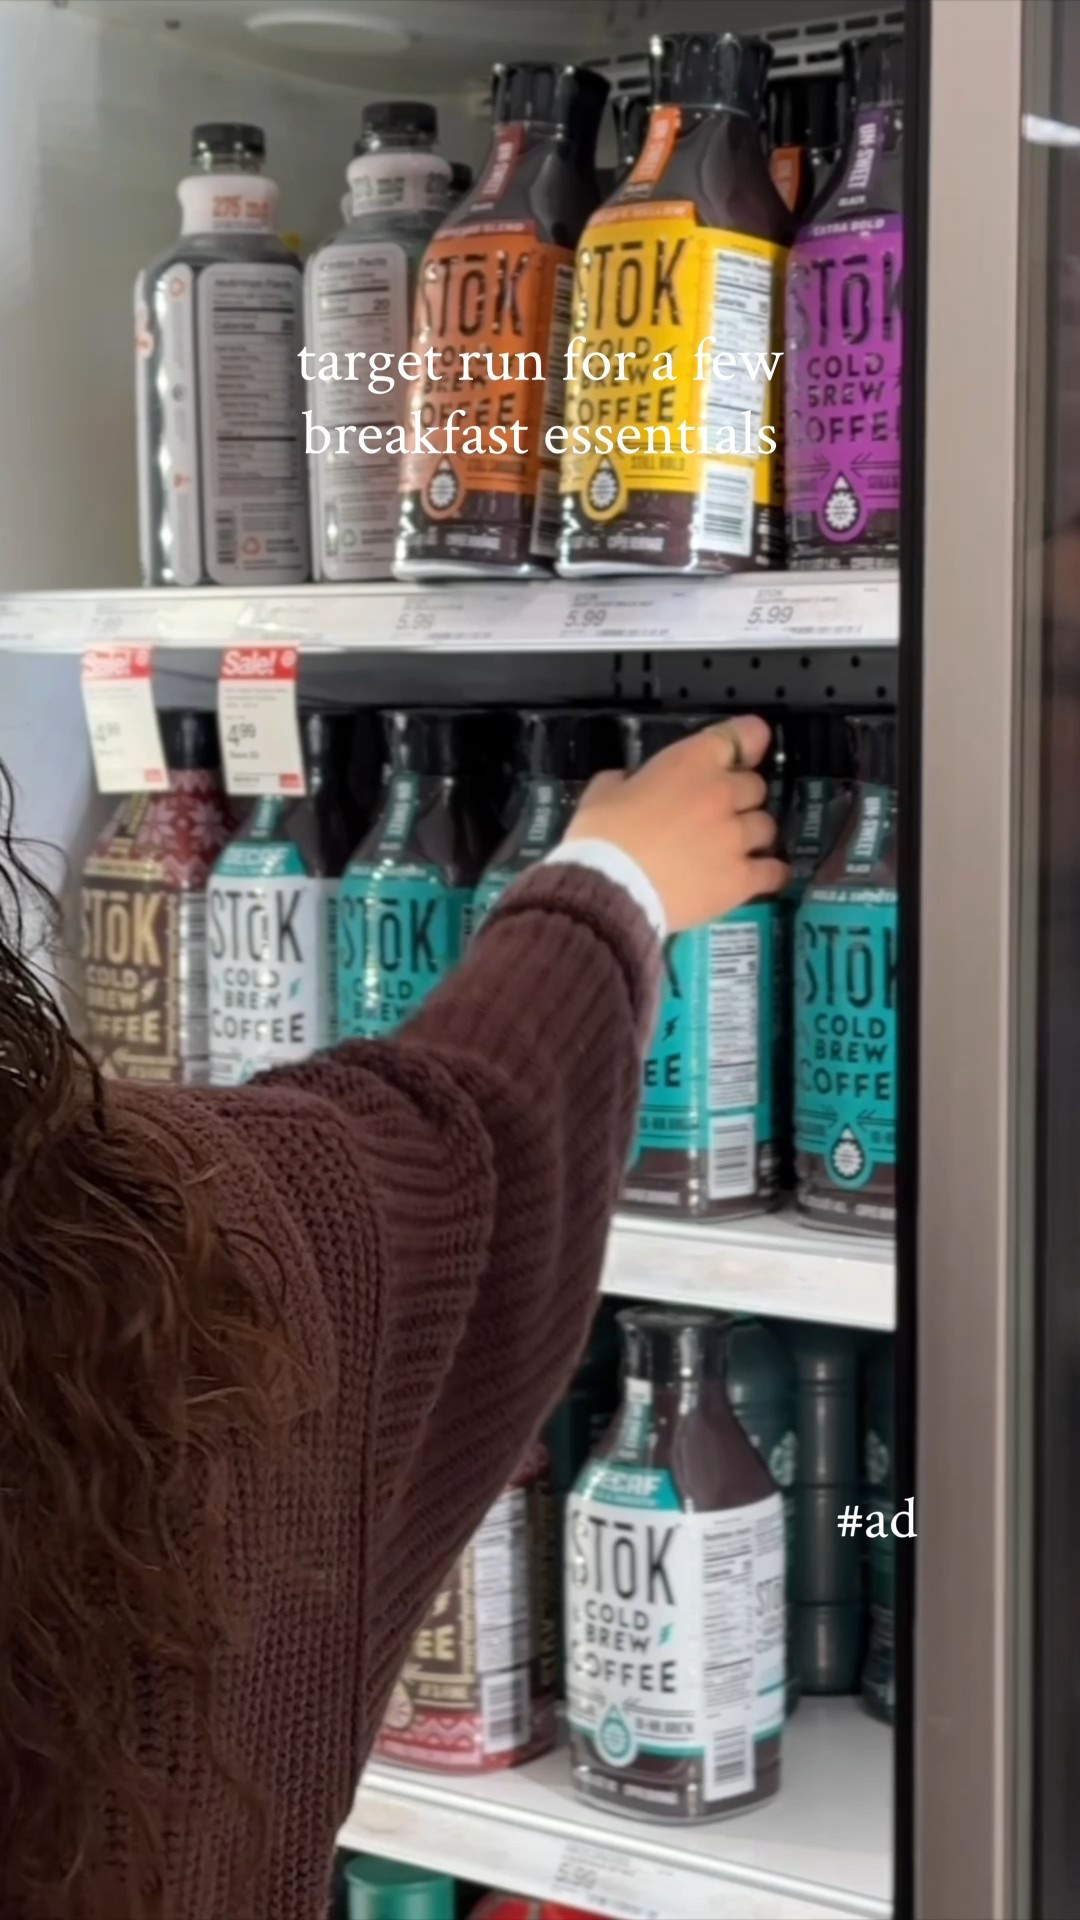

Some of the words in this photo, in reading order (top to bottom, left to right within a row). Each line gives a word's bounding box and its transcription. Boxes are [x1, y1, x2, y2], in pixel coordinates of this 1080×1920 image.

[564, 609, 607, 628] 5.99
[747, 606, 793, 625] 5.99
[221, 649, 277, 677] Sale!
[815, 1013, 886, 1039] COLD
[815, 1038, 888, 1065] BREW
[585, 1599, 649, 1632] COLD
[585, 1621, 650, 1655] BREW
